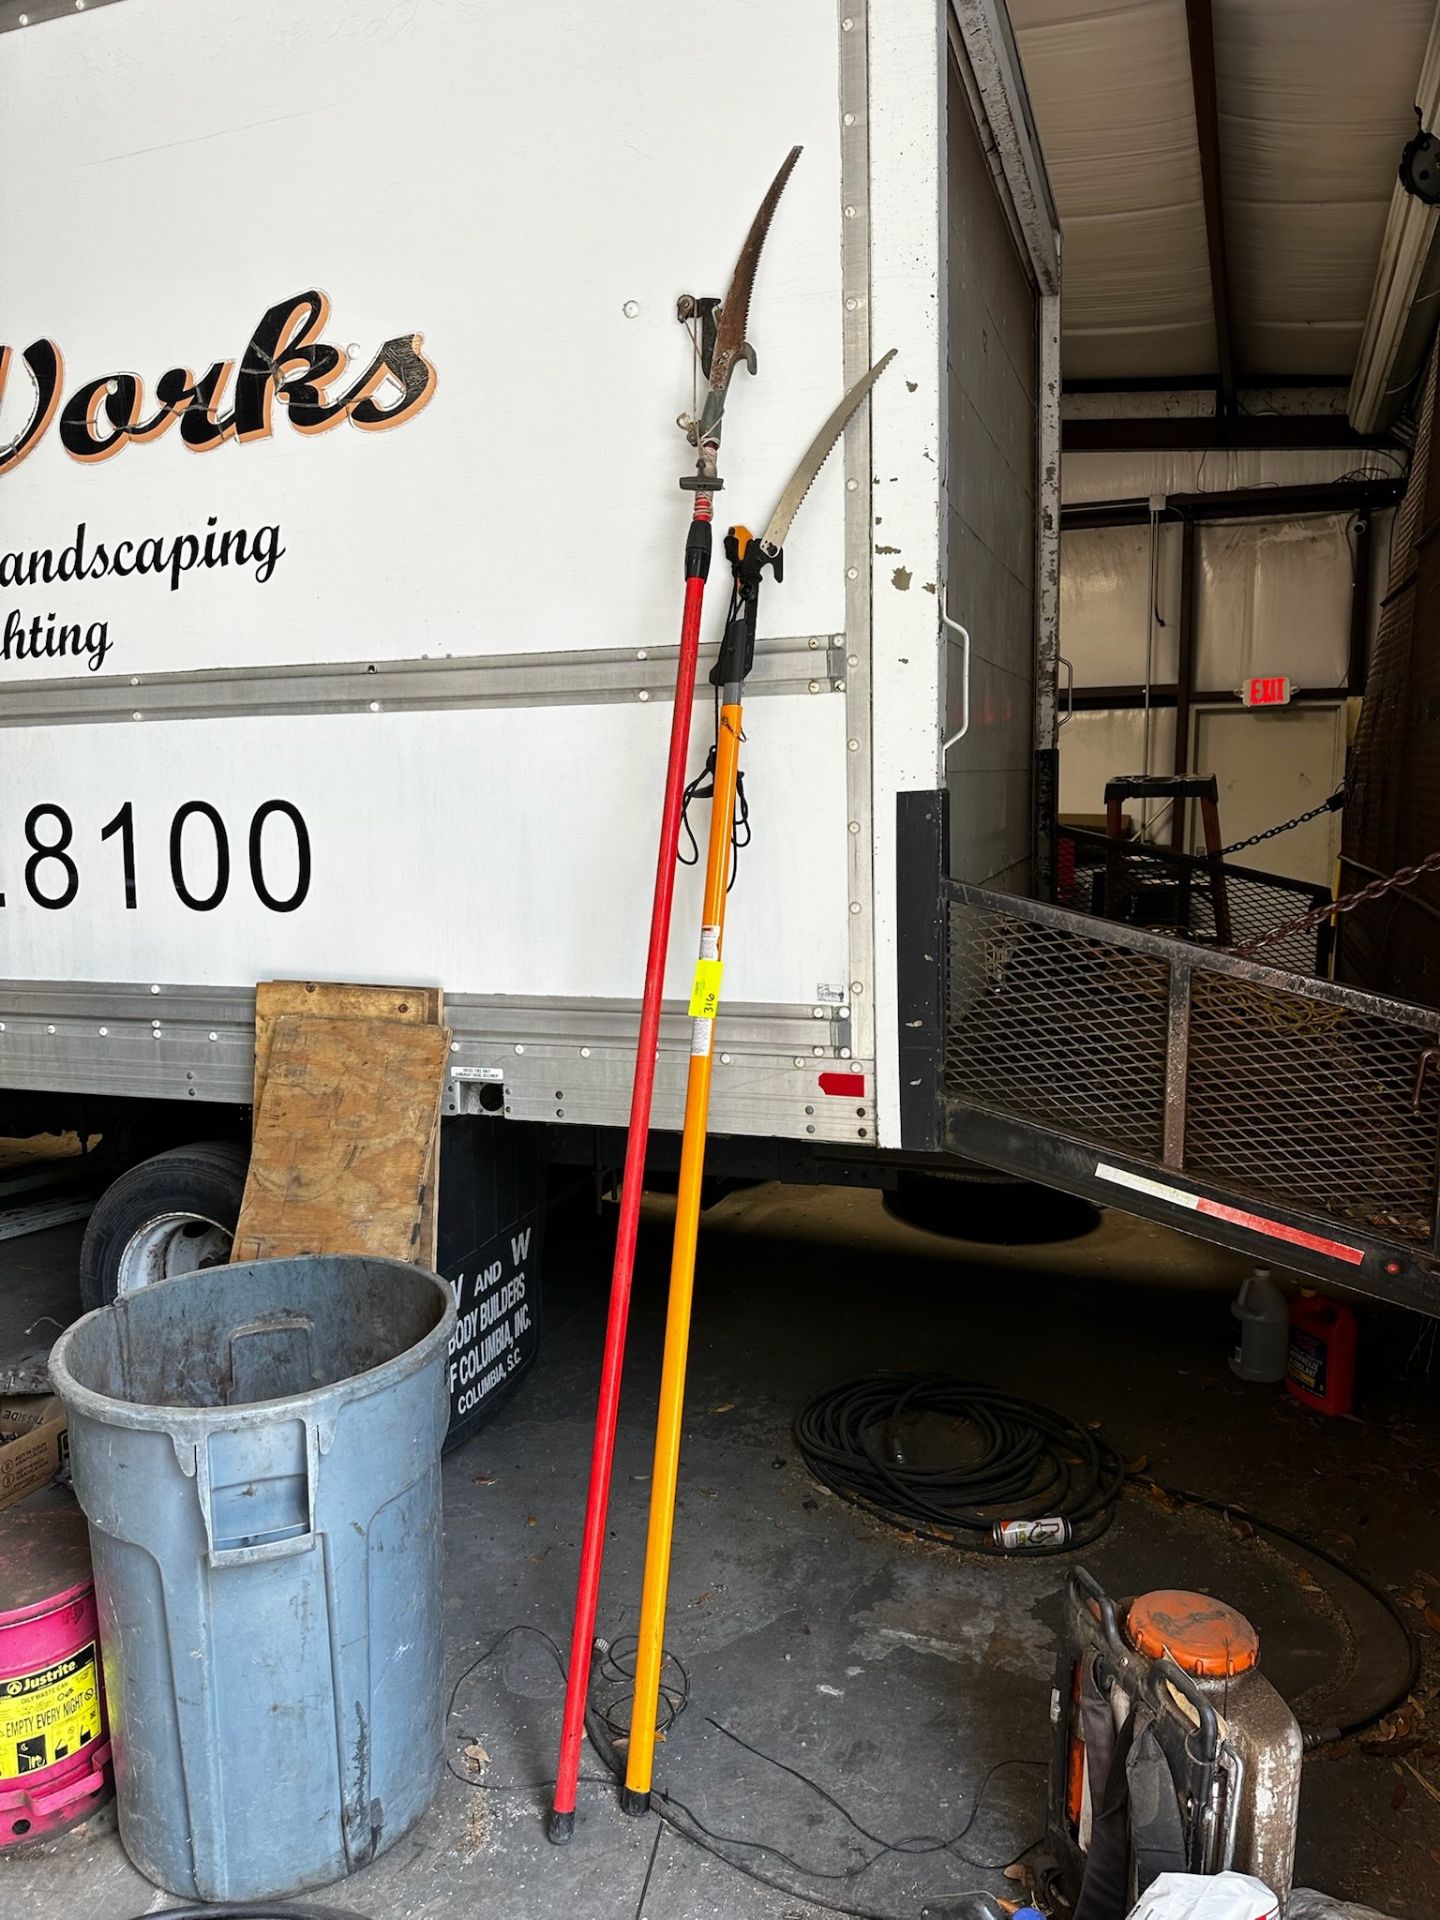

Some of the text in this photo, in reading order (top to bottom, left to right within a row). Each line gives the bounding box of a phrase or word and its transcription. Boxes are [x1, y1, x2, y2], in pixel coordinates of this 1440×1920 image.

[1251, 678, 1285, 704] EXIT
[704, 993, 715, 1013] 316
[473, 1260, 502, 1297] AND
[511, 1227, 532, 1266] W
[480, 1272, 526, 1333] BUILDERS
[459, 1320, 514, 1386] COLUMBIA,
[514, 1303, 532, 1339] INC.
[457, 1362, 507, 1415] COLUMBIA,
[23, 1661, 76, 1691] Justrite
[35, 1687, 55, 1699] WASTE
[6, 1716, 34, 1738] EMPTY
[36, 1705, 61, 1730] EVERY
[63, 1692, 84, 1717] NIGHT
